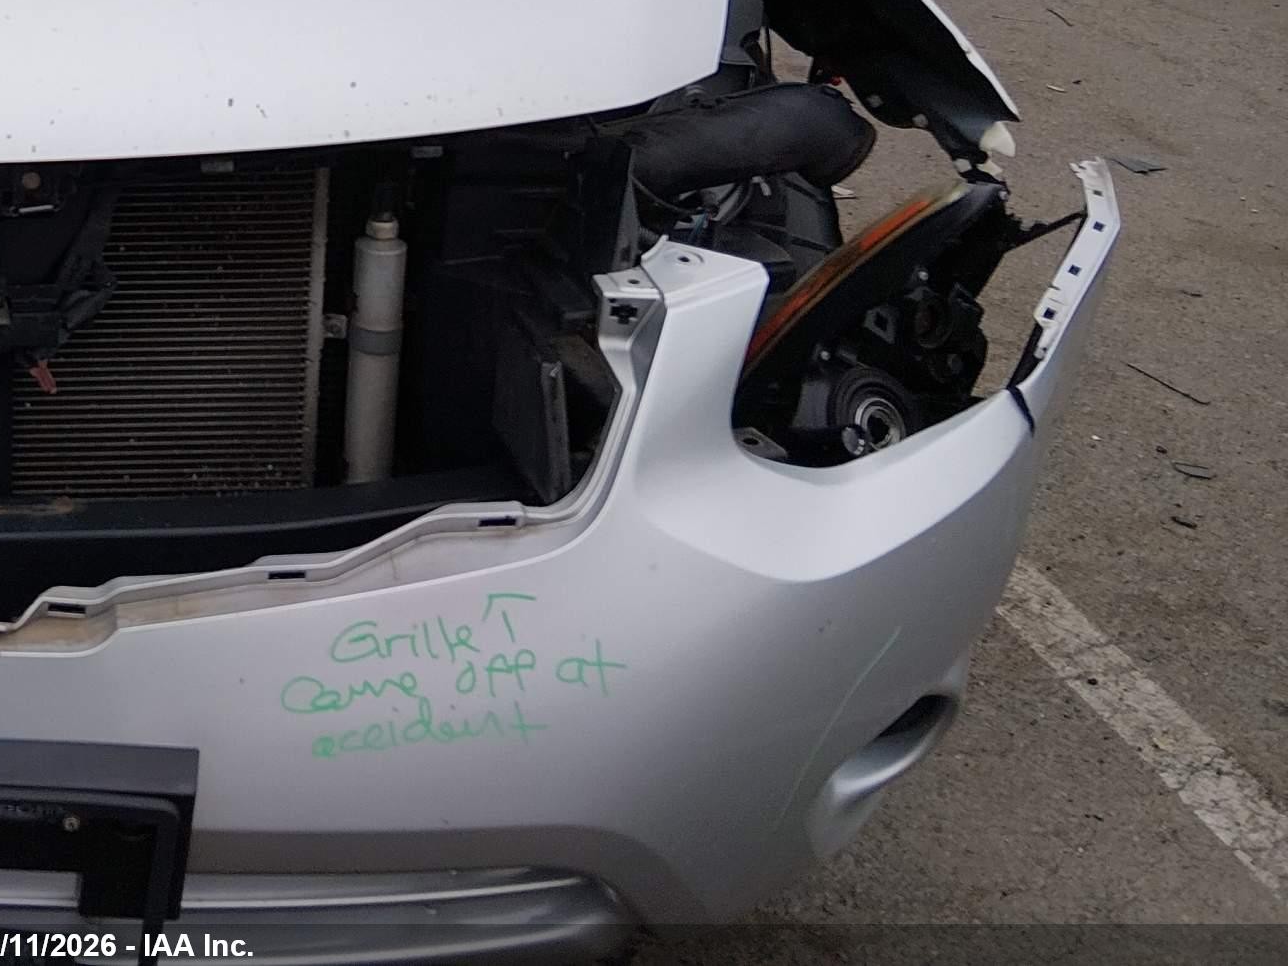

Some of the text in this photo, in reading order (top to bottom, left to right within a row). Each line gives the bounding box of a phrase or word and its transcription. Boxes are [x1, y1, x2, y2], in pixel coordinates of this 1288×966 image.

[330, 616, 480, 664] Grille
[455, 649, 537, 698] off
[556, 638, 627, 696] at
